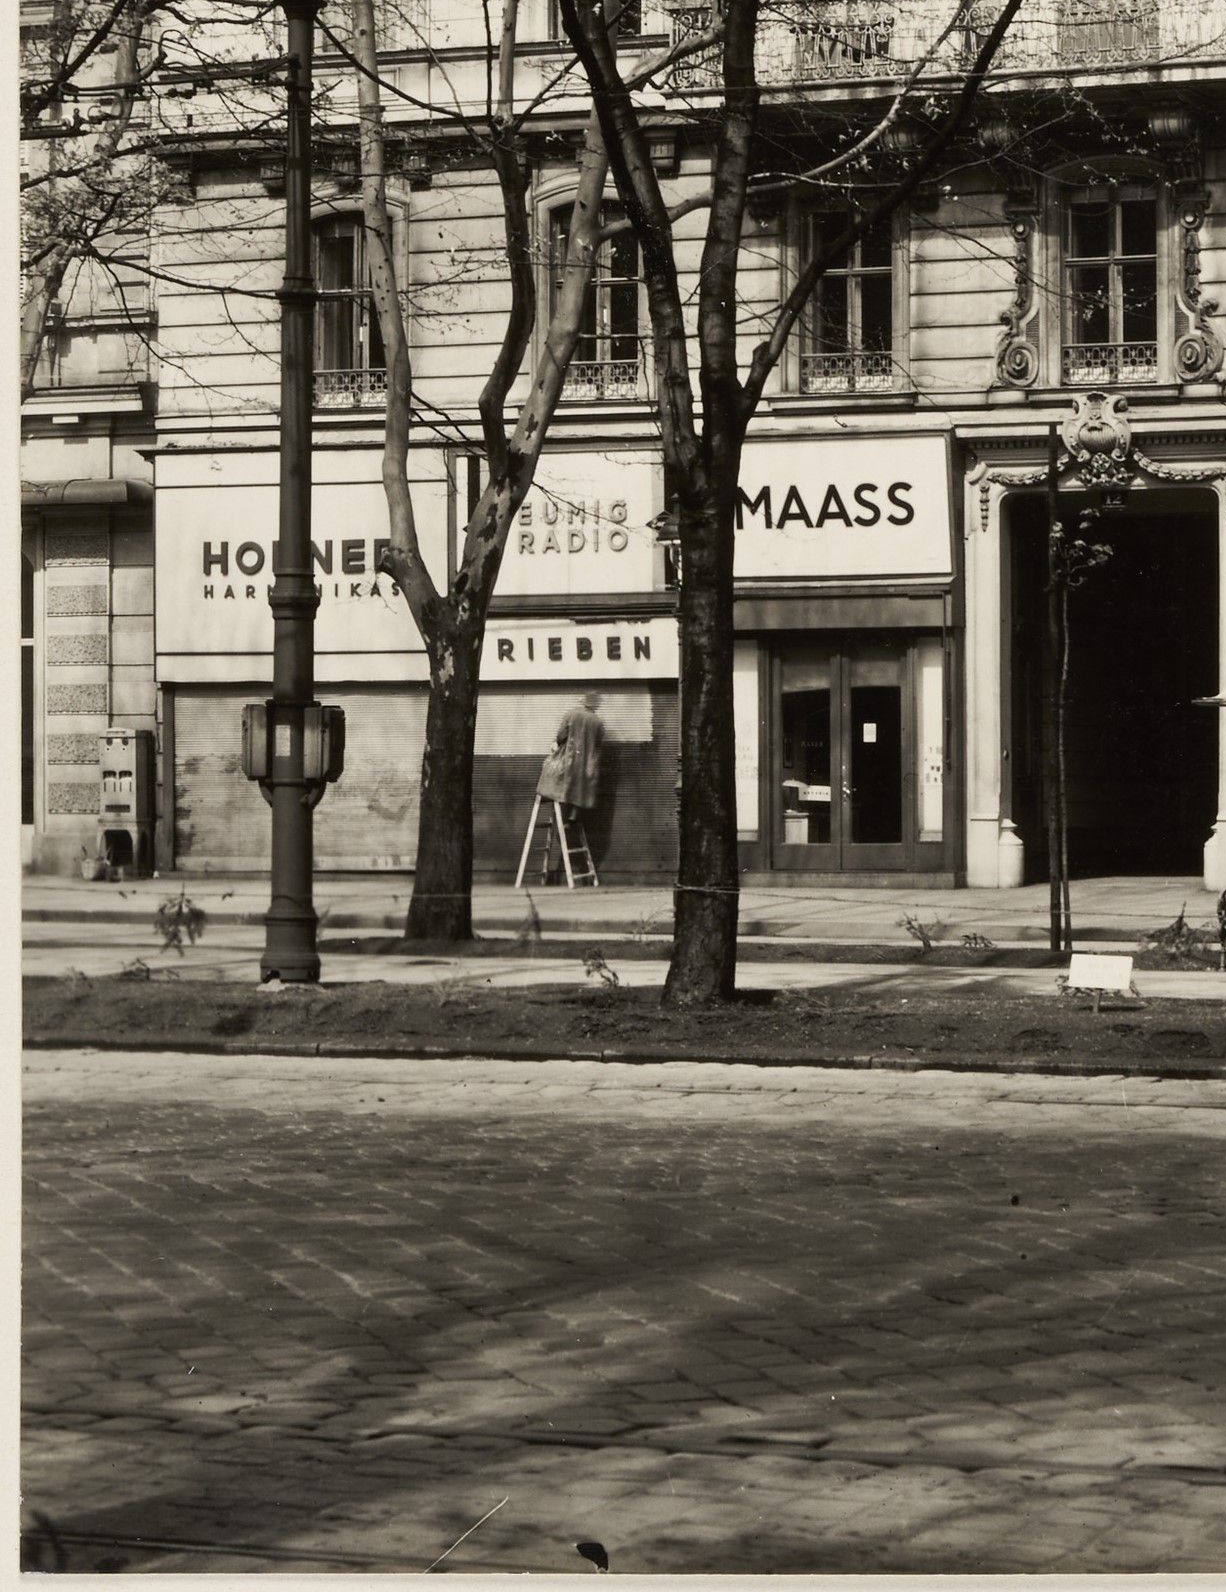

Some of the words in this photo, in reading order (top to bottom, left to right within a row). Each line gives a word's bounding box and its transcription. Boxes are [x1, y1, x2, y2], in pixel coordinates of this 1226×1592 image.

[518, 499, 628, 527] EUMIG
[734, 481, 915, 530] MAASS
[518, 528, 629, 555] RADIO
